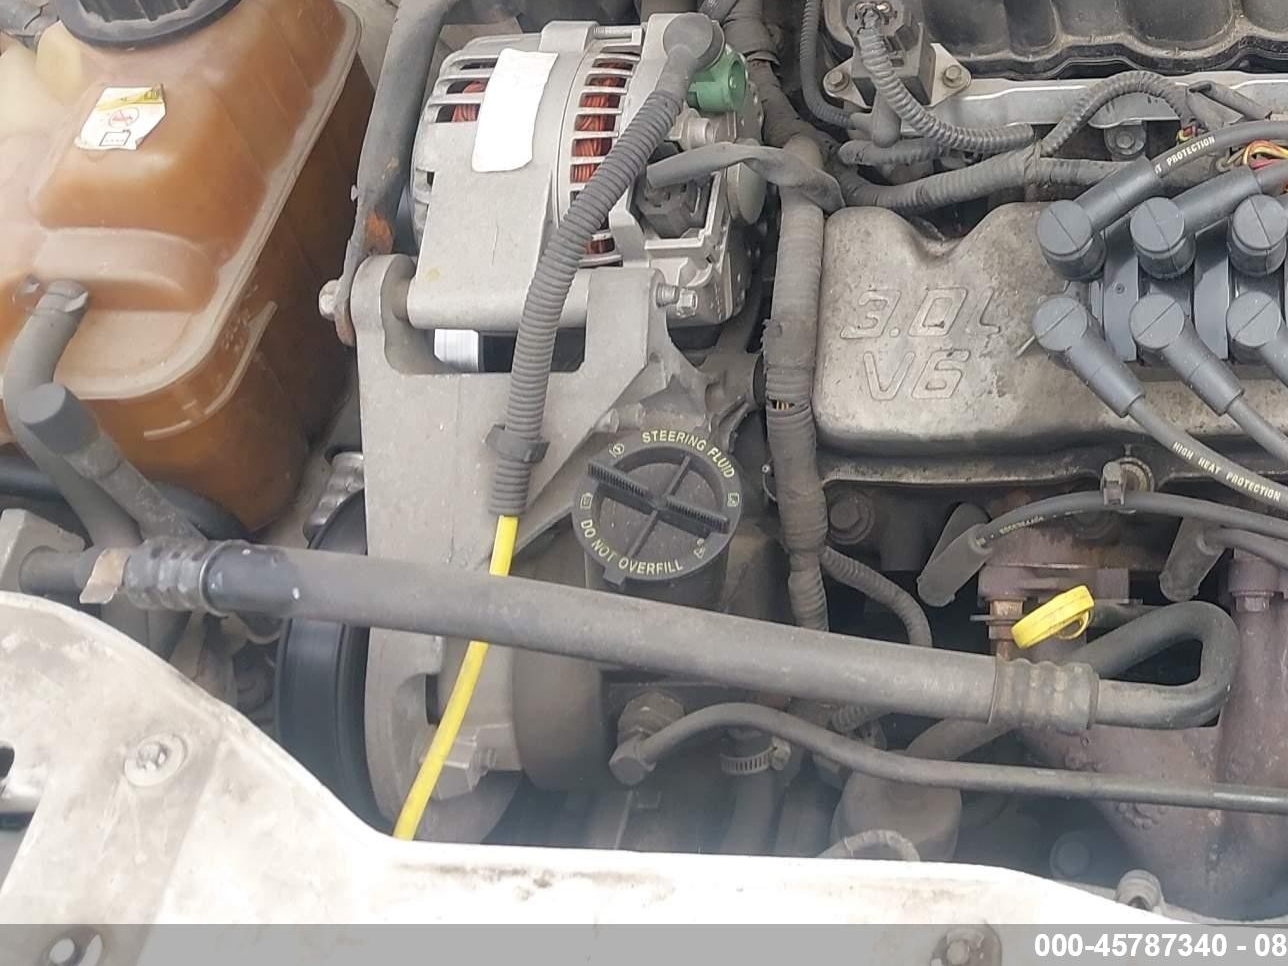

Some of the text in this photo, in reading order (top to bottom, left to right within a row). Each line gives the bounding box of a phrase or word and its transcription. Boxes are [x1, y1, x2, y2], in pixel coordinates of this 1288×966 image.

[1166, 136, 1215, 167] PROTECTION
[839, 286, 1001, 340] 3.0L
[863, 348, 972, 402] V6
[642, 429, 735, 479] STEERING FLUID
[1172, 441, 1194, 461] HIGH
[1198, 457, 1221, 475] HEAT
[1225, 472, 1282, 502] PROTECTION
[580, 519, 684, 576] DO NOT OVERFILL
